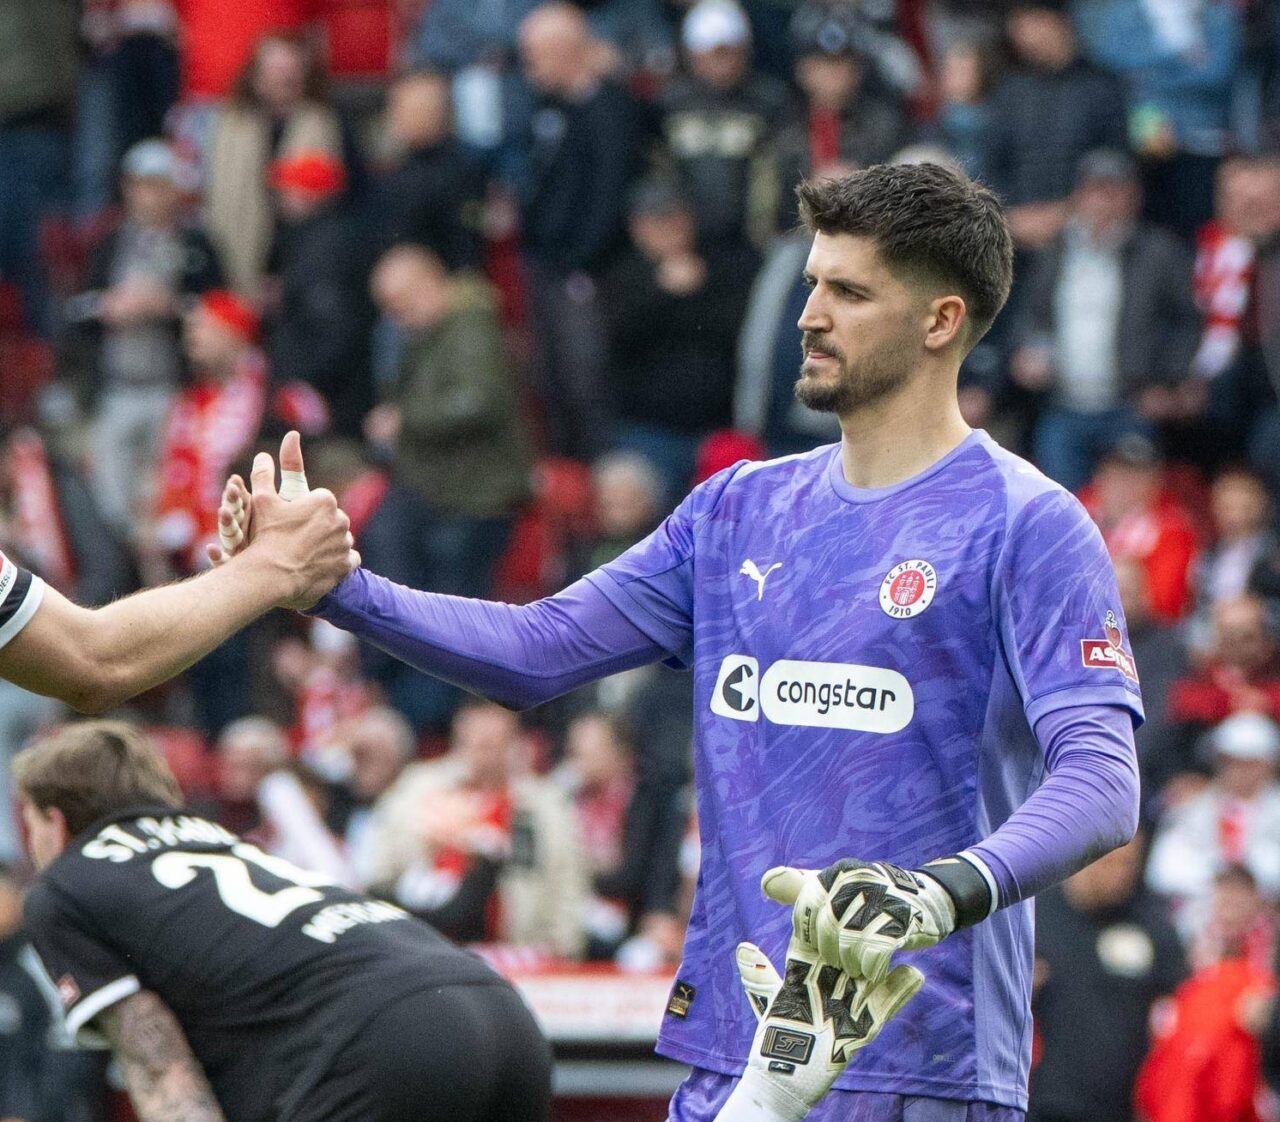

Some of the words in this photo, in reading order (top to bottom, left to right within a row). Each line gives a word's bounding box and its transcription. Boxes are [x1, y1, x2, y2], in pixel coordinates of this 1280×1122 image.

[884, 572, 896, 585] FC
[898, 562, 913, 573] ST.
[915, 561, 935, 589] PAULI
[888, 605, 912, 617] 1910
[777, 678, 896, 715] congstar
